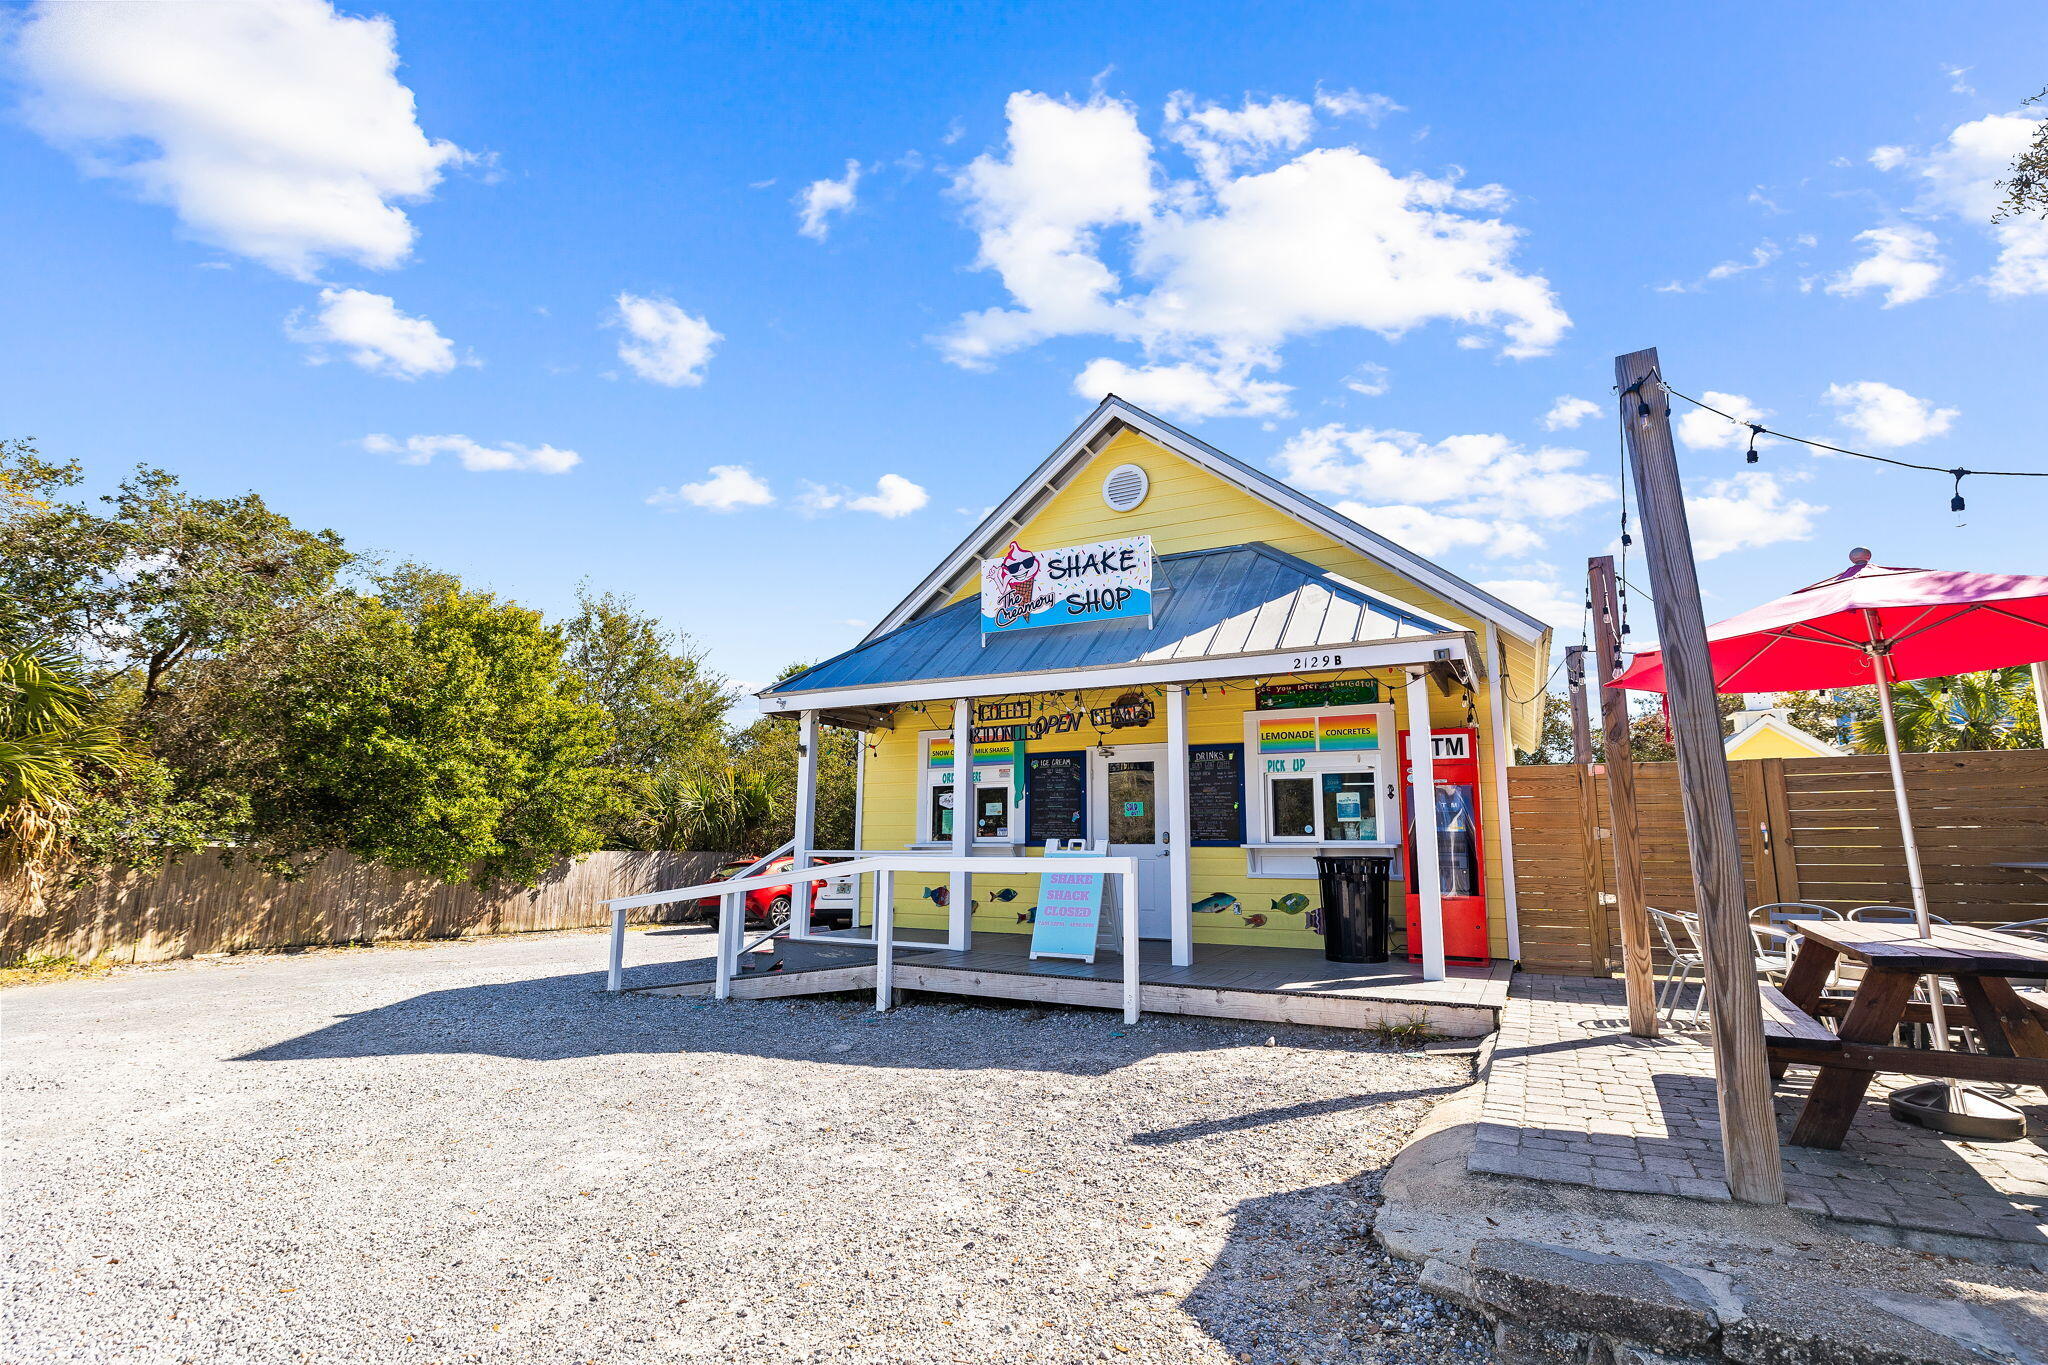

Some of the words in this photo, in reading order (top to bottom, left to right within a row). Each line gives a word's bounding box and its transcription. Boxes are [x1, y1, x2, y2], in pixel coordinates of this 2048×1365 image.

[1047, 549, 1137, 580] SHAKE
[998, 589, 1022, 608] The
[1066, 586, 1132, 615] SHOP
[995, 592, 1056, 627] Creamery
[1034, 712, 1083, 735] OPEN
[1261, 730, 1315, 741] LEMONADE
[1325, 727, 1371, 736] CONCRETES
[1431, 737, 1464, 756] TM
[1195, 751, 1224, 760] DRINKS
[1267, 759, 1285, 772] PICK
[1292, 758, 1306, 771] UP
[1050, 874, 1092, 884] SHAKE
[1046, 890, 1089, 901] SHACK
[1044, 906, 1091, 917] CLOSED
